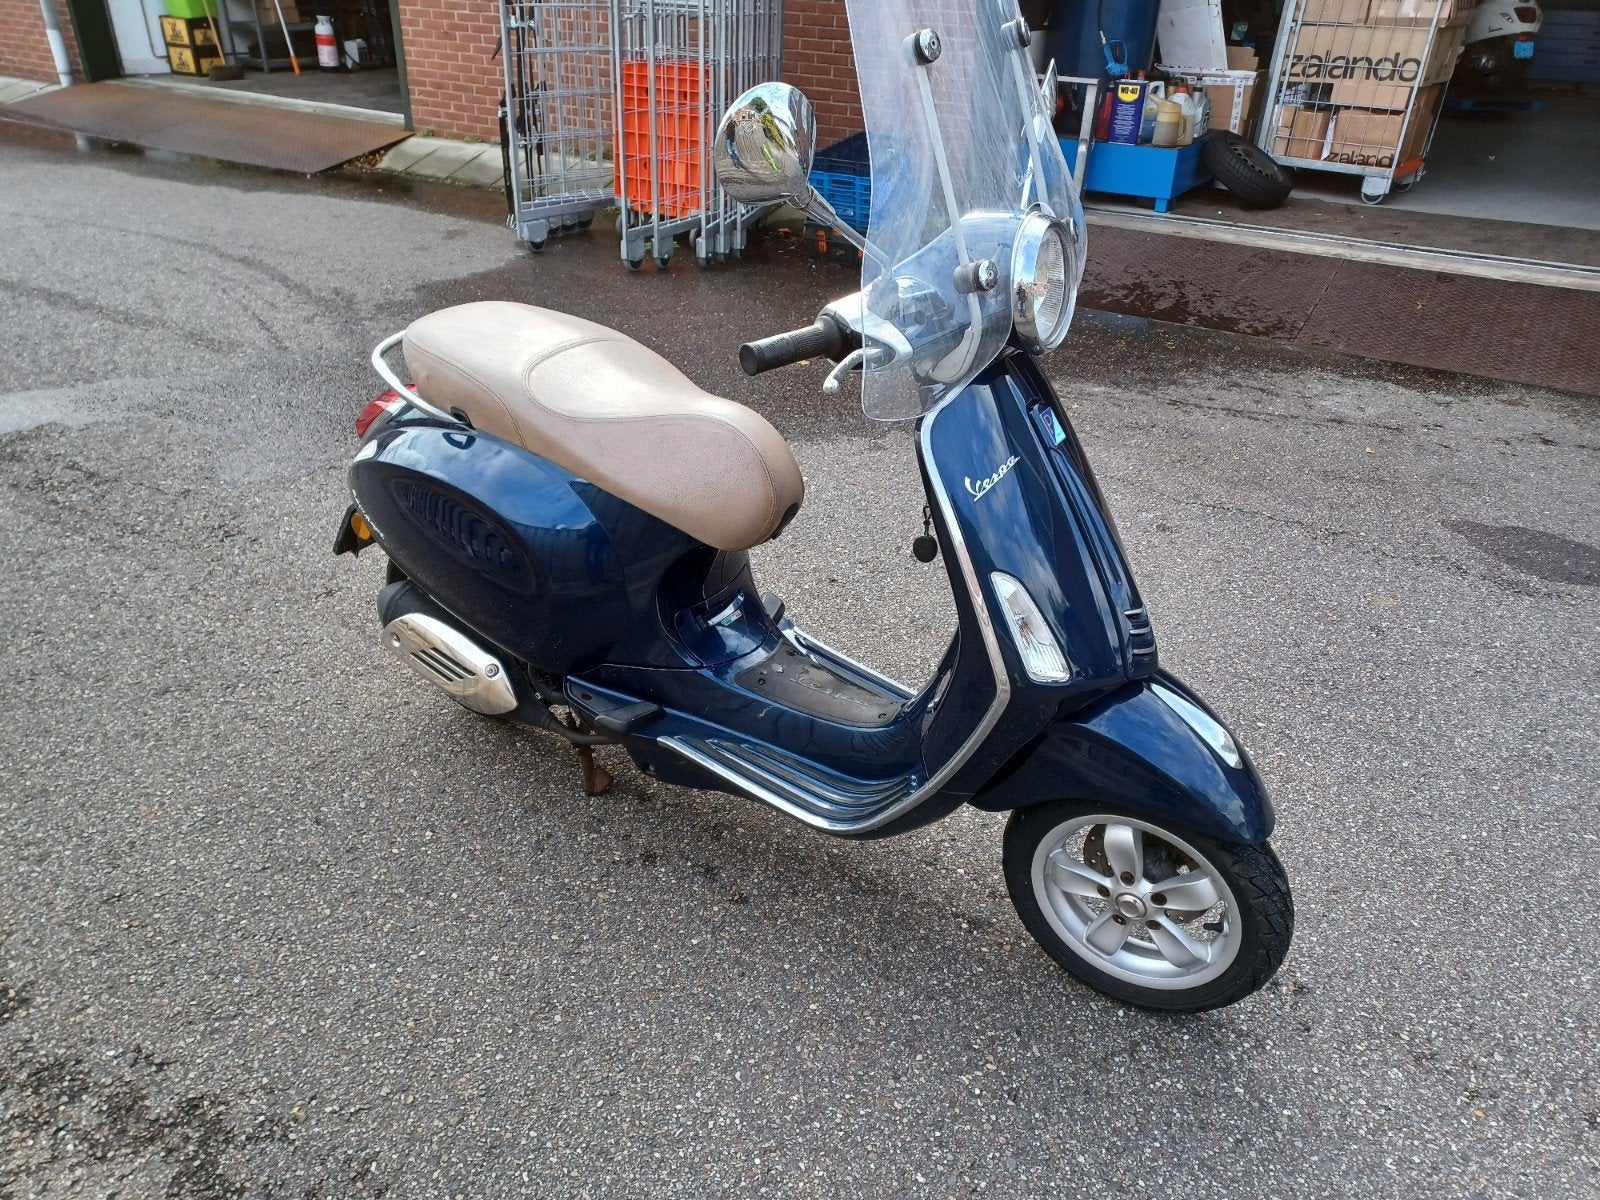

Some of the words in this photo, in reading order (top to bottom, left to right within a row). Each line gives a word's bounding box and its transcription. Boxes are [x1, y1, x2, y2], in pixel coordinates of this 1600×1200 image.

[1281, 50, 1422, 82] zalando
[1120, 86, 1138, 95] WD-40
[1324, 150, 1395, 168] zaland
[964, 455, 1021, 503] Vespa
